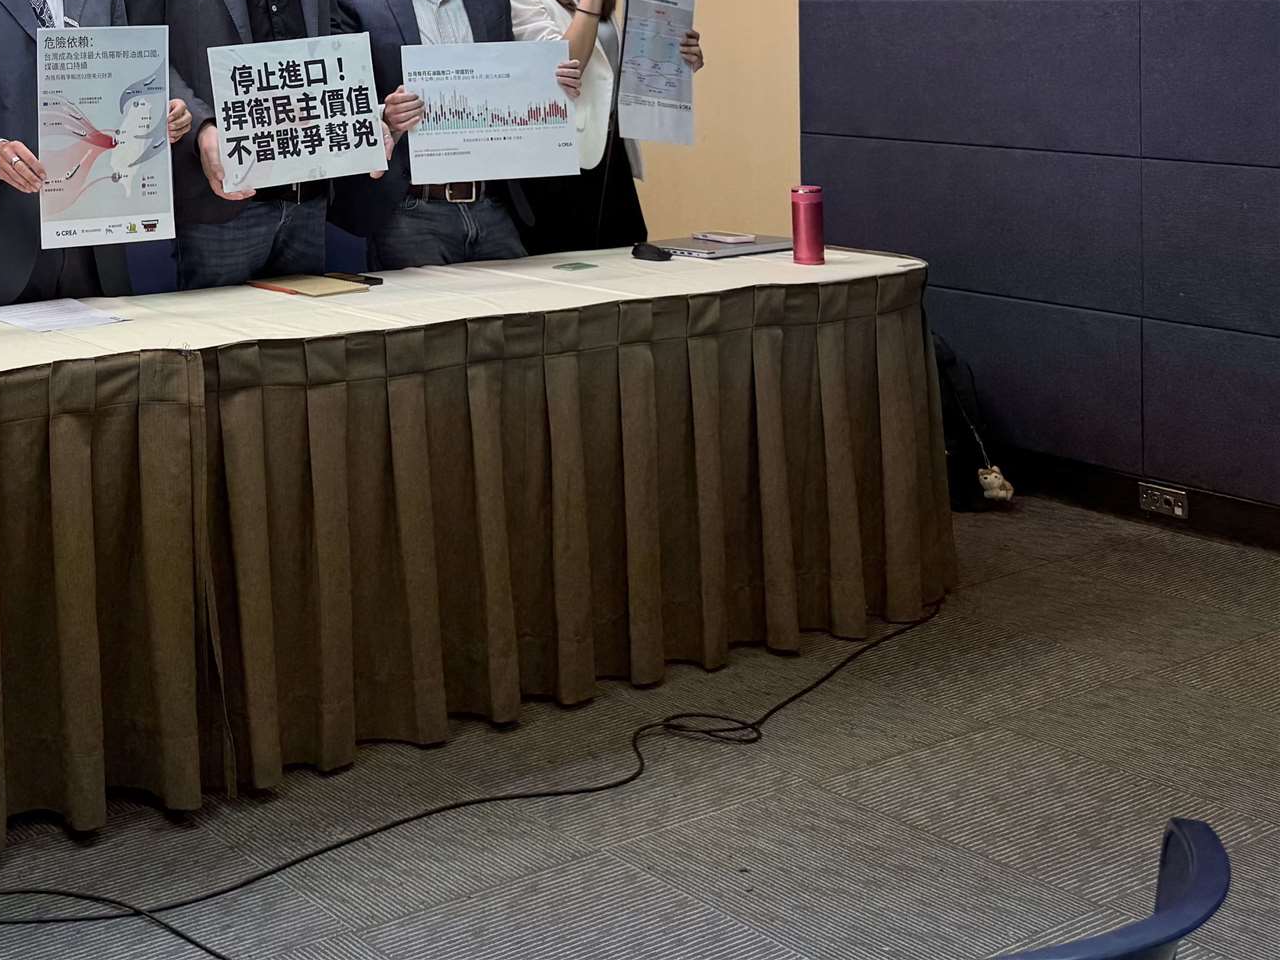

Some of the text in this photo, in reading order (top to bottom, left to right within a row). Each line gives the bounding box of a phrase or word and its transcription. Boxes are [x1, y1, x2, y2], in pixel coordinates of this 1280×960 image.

[230, 57, 346, 96] 停止進口！
[221, 85, 373, 132] 捍衛民主價值
[226, 118, 378, 166] 不當戰爭幫兇
[61, 229, 78, 237] CREA
